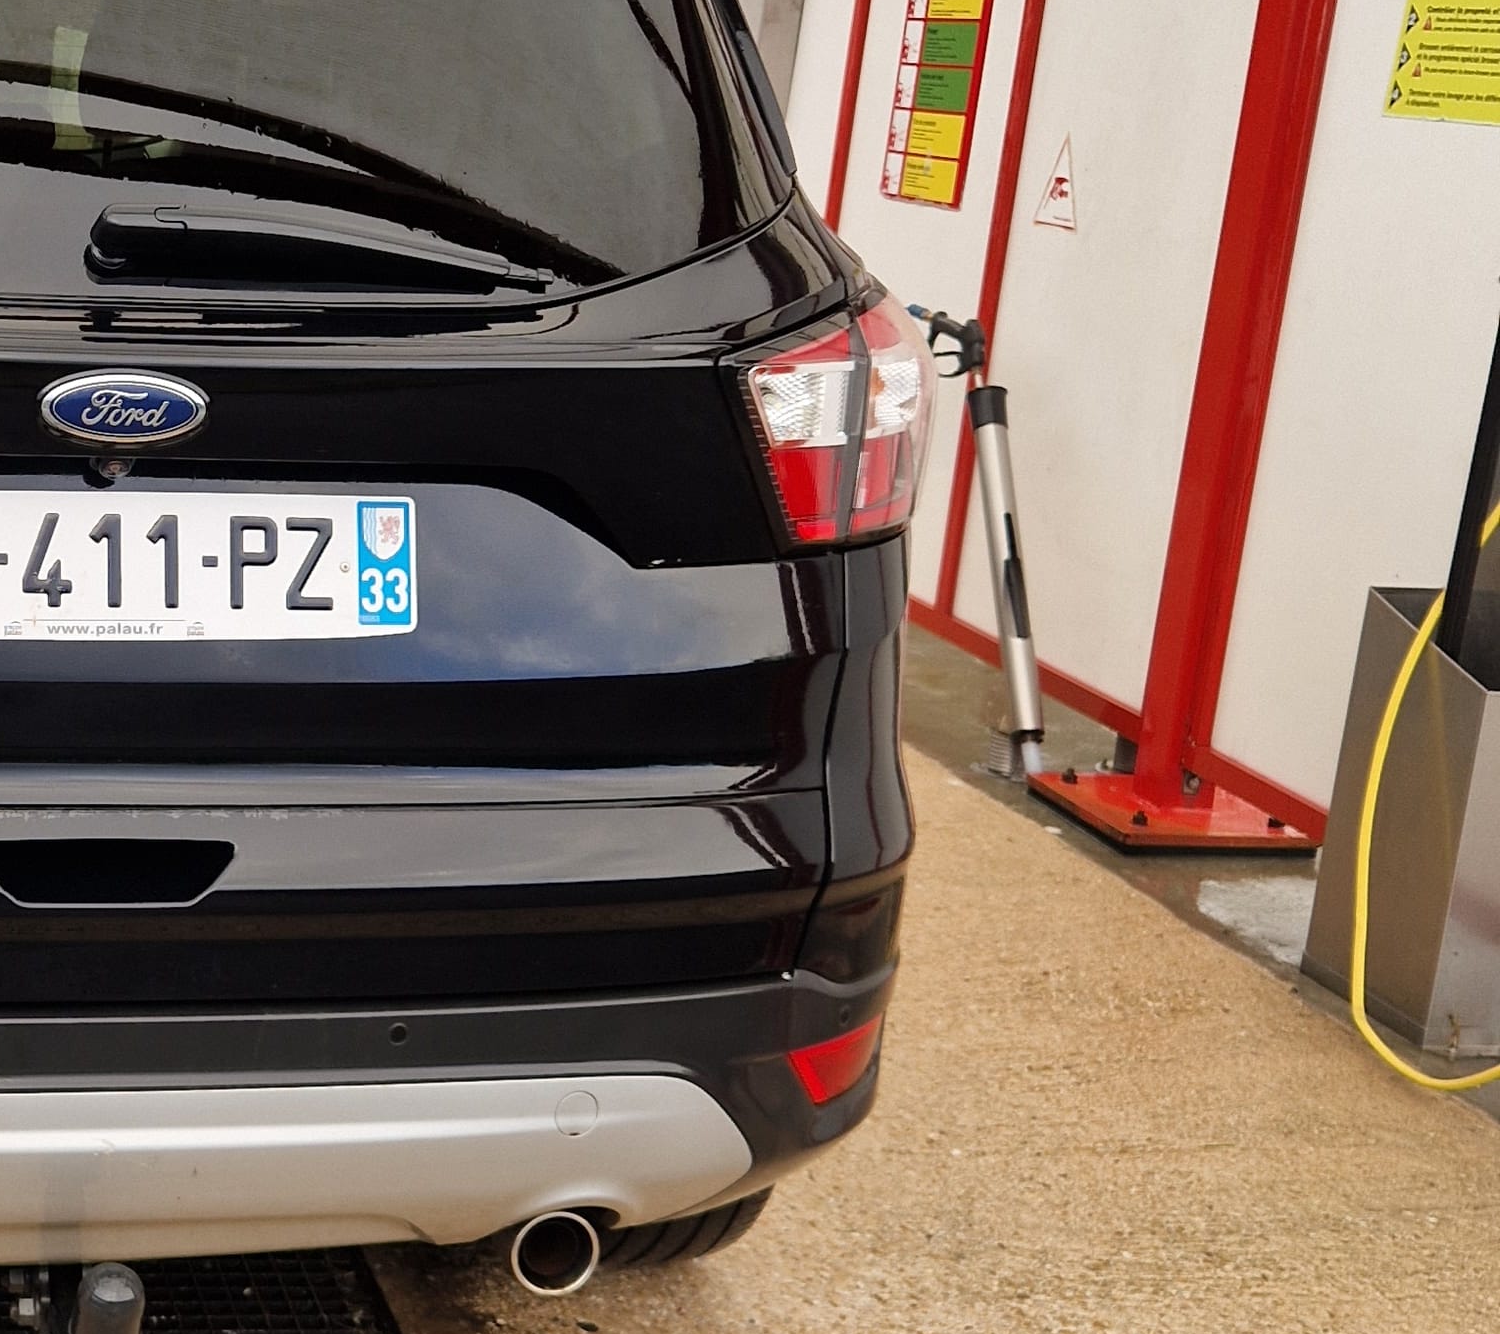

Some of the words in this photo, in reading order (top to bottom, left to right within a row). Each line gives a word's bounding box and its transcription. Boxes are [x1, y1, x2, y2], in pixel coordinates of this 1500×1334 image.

[81, 389, 170, 428] Ford
[361, 567, 409, 613] 33
[46, 622, 164, 637] www.palau.fr
